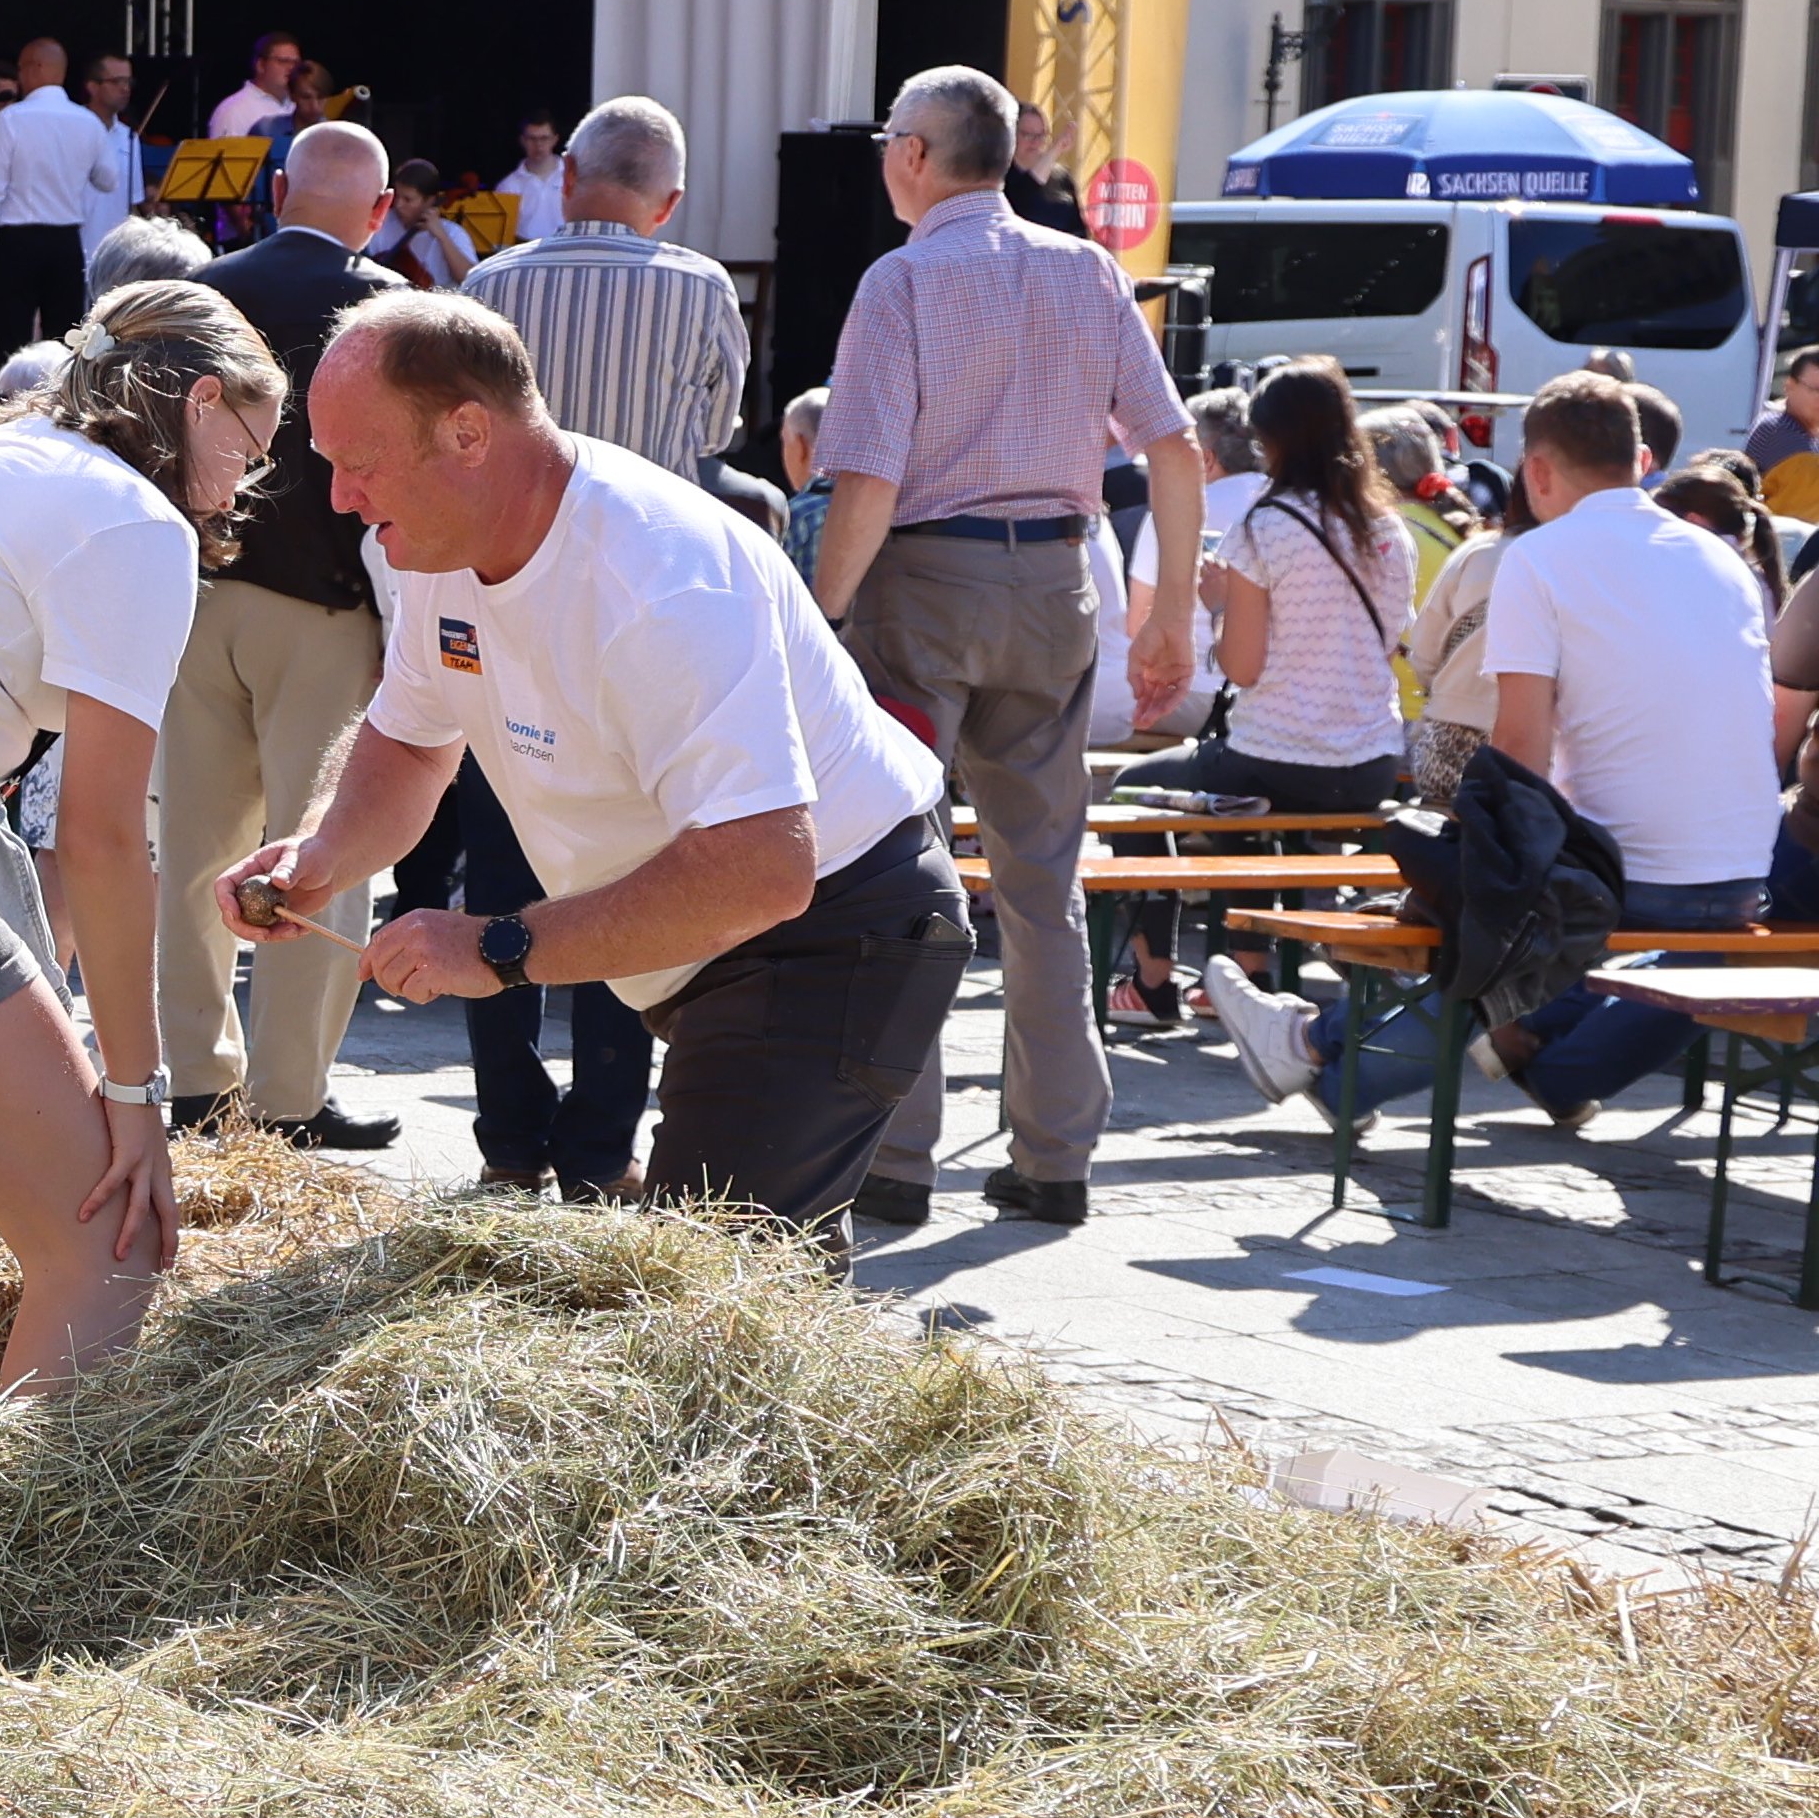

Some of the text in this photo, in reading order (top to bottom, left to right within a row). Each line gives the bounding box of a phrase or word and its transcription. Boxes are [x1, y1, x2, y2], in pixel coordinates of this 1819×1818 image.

[1097, 181, 1148, 201] MITTEN
[1437, 171, 1521, 197] SACHSEN
[1522, 171, 1590, 197] QUELLE
[1095, 202, 1147, 229] DRIN
[450, 656, 474, 671] TEAM
